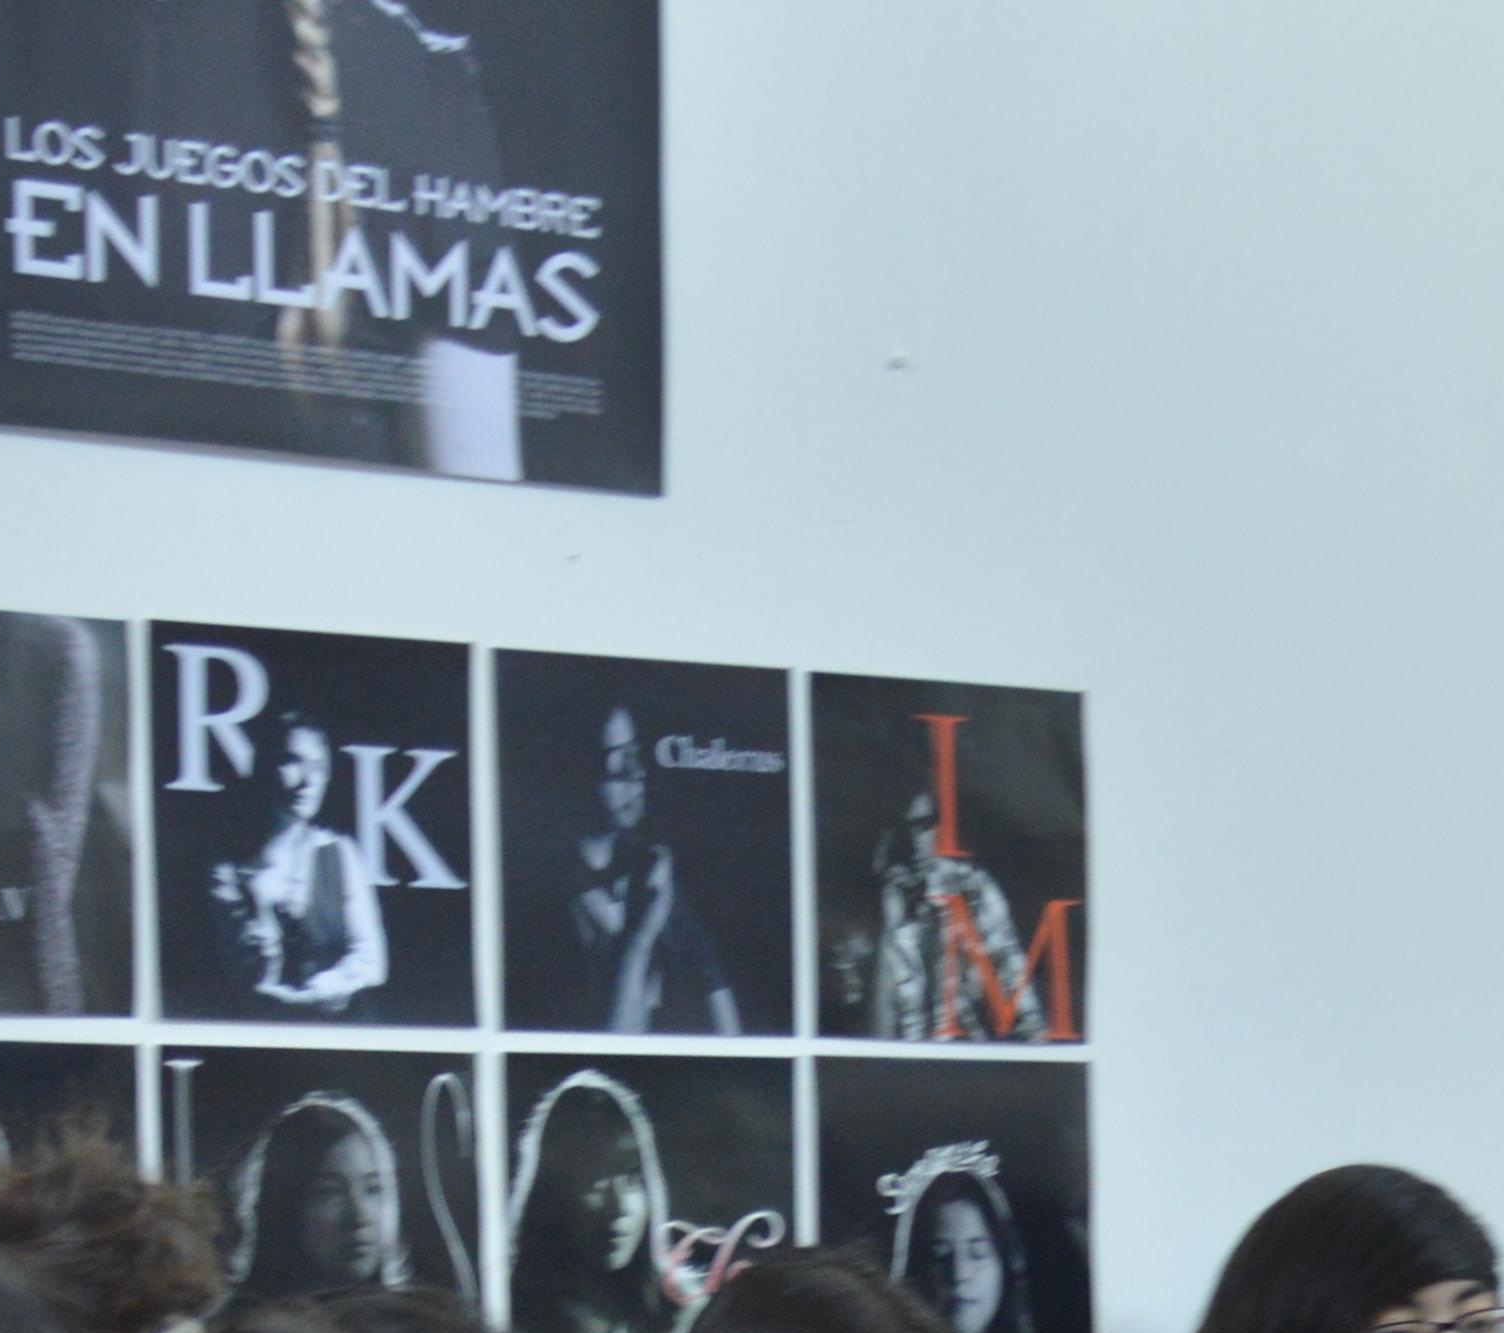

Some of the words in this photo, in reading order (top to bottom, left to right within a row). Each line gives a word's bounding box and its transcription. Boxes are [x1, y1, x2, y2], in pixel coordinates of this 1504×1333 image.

[3, 114, 106, 172] LOS
[114, 131, 307, 200] JUEGOS
[317, 158, 406, 213] DEL
[412, 172, 603, 240] HAMBRE
[4, 178, 160, 288] EN
[187, 201, 601, 344] LLAMAS
[160, 642, 271, 793] R
[339, 744, 470, 891] K
